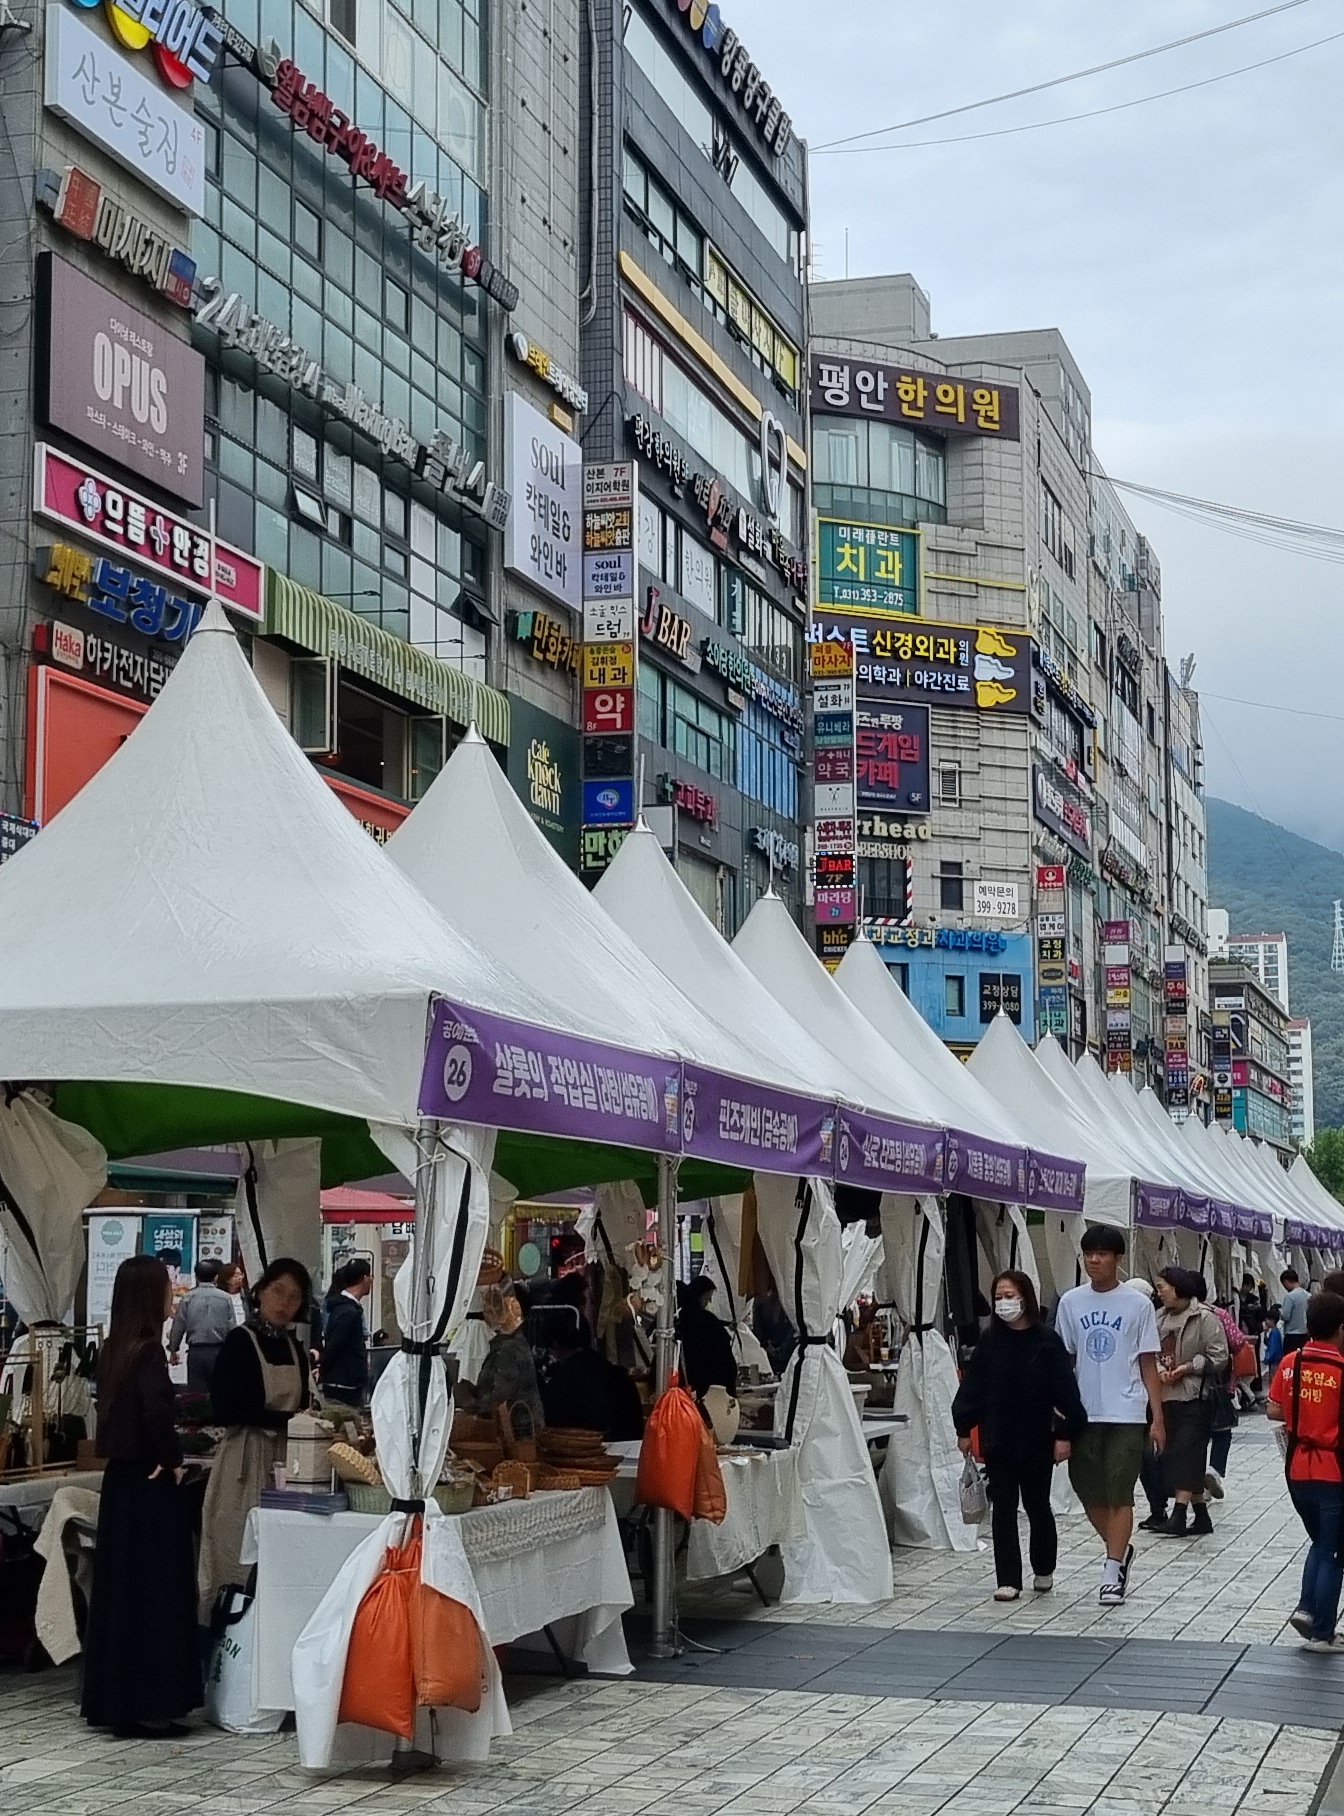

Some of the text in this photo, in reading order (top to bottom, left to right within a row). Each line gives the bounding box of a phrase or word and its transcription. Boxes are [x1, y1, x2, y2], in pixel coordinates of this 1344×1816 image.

[721, 27, 793, 157] 킹콩당구클럽
[72, 51, 178, 175] 산본술집
[190, 126, 202, 144] 4F
[96, 197, 171, 291] 마사지
[110, 317, 155, 357] 다이닝 레스토랑
[93, 332, 167, 434] OPUS
[818, 362, 1002, 430] 평안 한의원
[177, 451, 188, 475] 3F
[531, 436, 566, 491] soul
[586, 466, 627, 480] 산본 7F
[586, 481, 630, 494] 이지어학원
[525, 481, 571, 543] 칵테일&
[105, 489, 146, 546] 으뜸
[172, 524, 209, 578] 안경
[529, 533, 568, 589] 와인바
[595, 554, 622, 569] soul
[836, 541, 904, 587] 치과
[591, 570, 626, 583] 칵테일&
[593, 582, 623, 594] 와인바
[87, 556, 202, 649] 보청기
[589, 605, 628, 617] 소울 믹스
[595, 619, 623, 640] 드럼
[657, 604, 691, 660] BAR
[806, 621, 957, 665] 퍼스트 신경외과
[87, 632, 173, 699] 하카전자담
[813, 654, 851, 668] 마사지
[590, 667, 628, 685] 내과
[914, 669, 971, 694] 야간진료
[594, 693, 625, 729] 약
[817, 694, 843, 708] 설화
[531, 737, 550, 765] Cafe
[527, 748, 562, 795] knock
[817, 762, 850, 778] 약국
[857, 761, 899, 790] 카페
[910, 792, 922, 802] 5F
[825, 873, 844, 883] 7F
[978, 885, 1014, 898] 예약문의
[823, 928, 848, 945] bhc
[1041, 939, 1062, 949] 교정
[1041, 950, 1063, 960] 치과
[982, 1001, 1019, 1012] 399-080
[1168, 1040, 1185, 1050] BAR
[447, 1041, 549, 1102] 26 샬롯의
[684, 1106, 694, 1129] 25
[1079, 1311, 1123, 1332] UCLA
